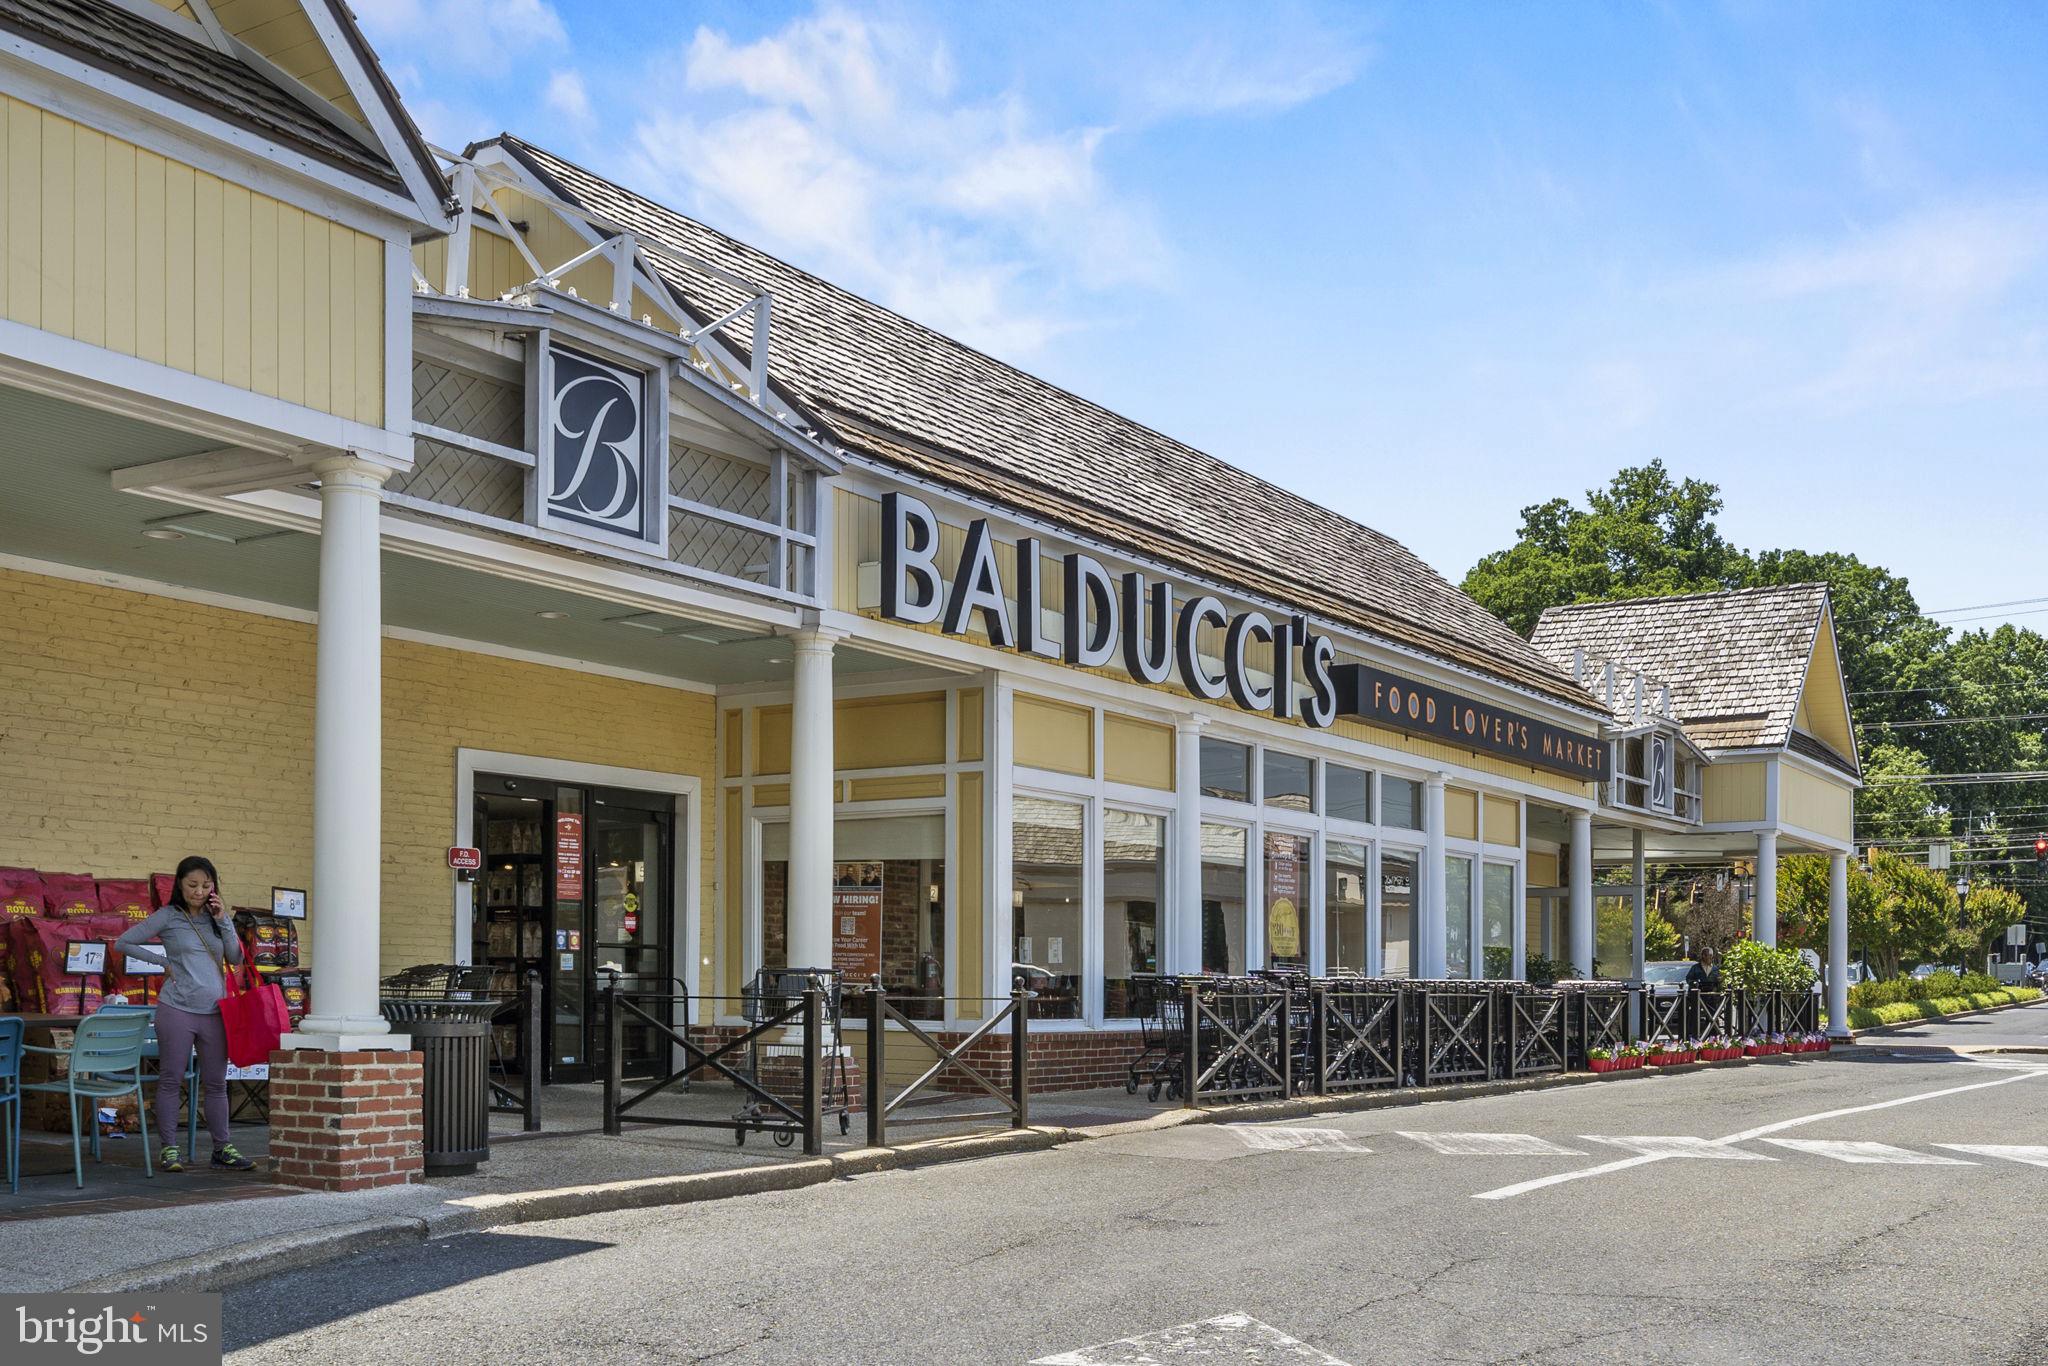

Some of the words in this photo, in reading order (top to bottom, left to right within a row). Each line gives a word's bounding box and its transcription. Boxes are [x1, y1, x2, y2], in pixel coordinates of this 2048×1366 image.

[550, 375, 638, 519] B
[881, 492, 1337, 728] BALDUCCI'S
[1374, 682, 1437, 723] FOOD
[1453, 705, 1528, 750] LOVER'S
[1543, 734, 1602, 771] MARKET
[453, 857, 476, 866] ACCESS
[842, 895, 879, 904] HIRING!
[6, 905, 37, 914] ROYAL
[119, 910, 149, 919] OYAL
